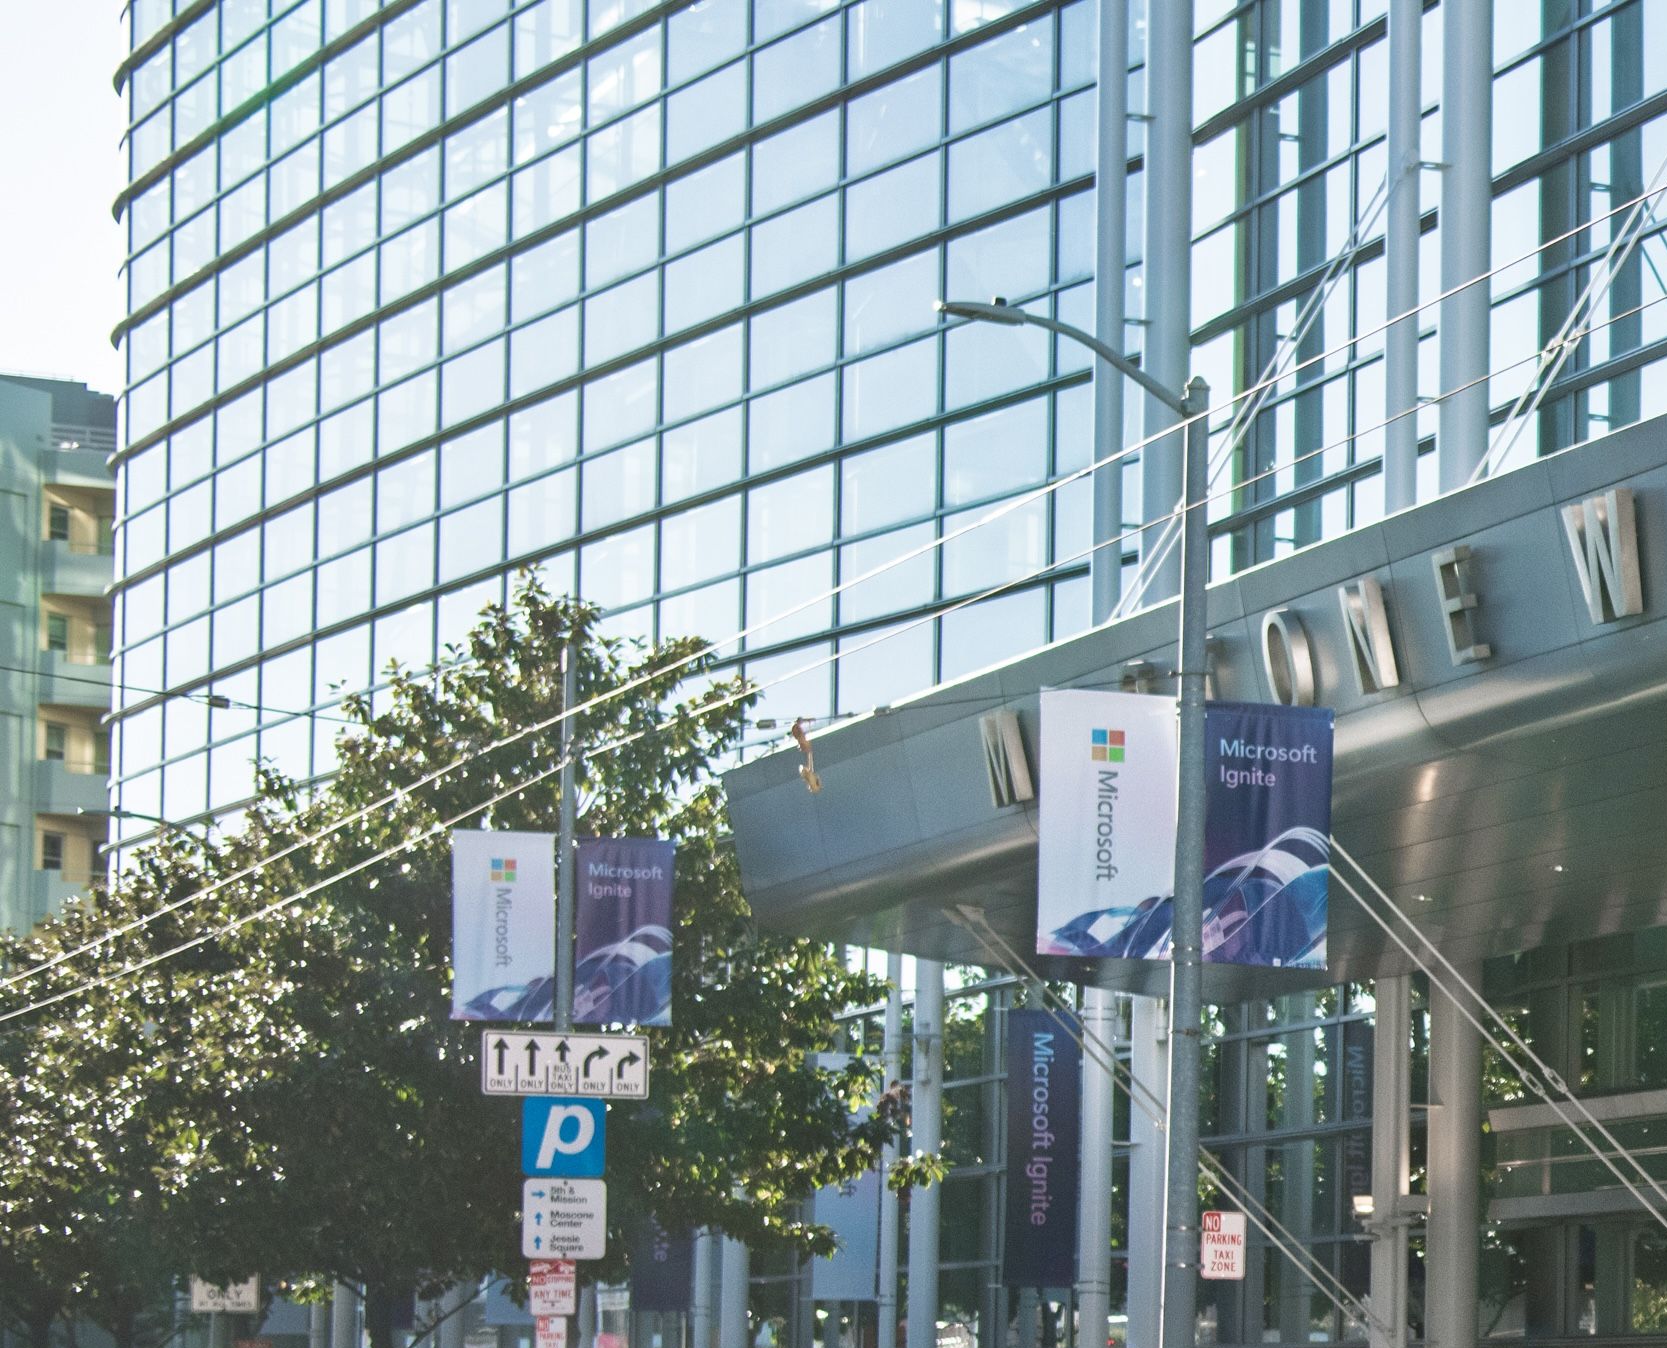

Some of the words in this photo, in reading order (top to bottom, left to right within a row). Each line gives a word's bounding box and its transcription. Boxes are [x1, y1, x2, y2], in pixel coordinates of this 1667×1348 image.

[1220, 738, 1317, 765] Microsoft
[1220, 765, 1276, 789] Ignite
[1096, 770, 1119, 883] Microsoft
[588, 863, 664, 881] Microsoft
[588, 884, 632, 900] Ignite
[496, 888, 513, 968] Microsoft
[489, 1078, 514, 1089] ONLY
[520, 1079, 544, 1090] ONLY
[550, 1081, 574, 1091] ONLY
[583, 1081, 607, 1091] ONLY
[616, 1082, 641, 1092] ONLY
[1032, 1032, 1055, 1150] Microsoft
[550, 1196, 588, 1204] Mission
[1026, 1157, 1054, 1227] Ignite
[550, 1211, 594, 1219] Moscone
[1205, 1215, 1220, 1231] NO
[550, 1220, 583, 1228] Center
[1206, 1234, 1242, 1246] PARKING
[1214, 1250, 1234, 1260] TAXI
[1211, 1262, 1236, 1272] ZONE
[534, 1290, 550, 1299] ANY
[554, 1289, 572, 1298] TIME
